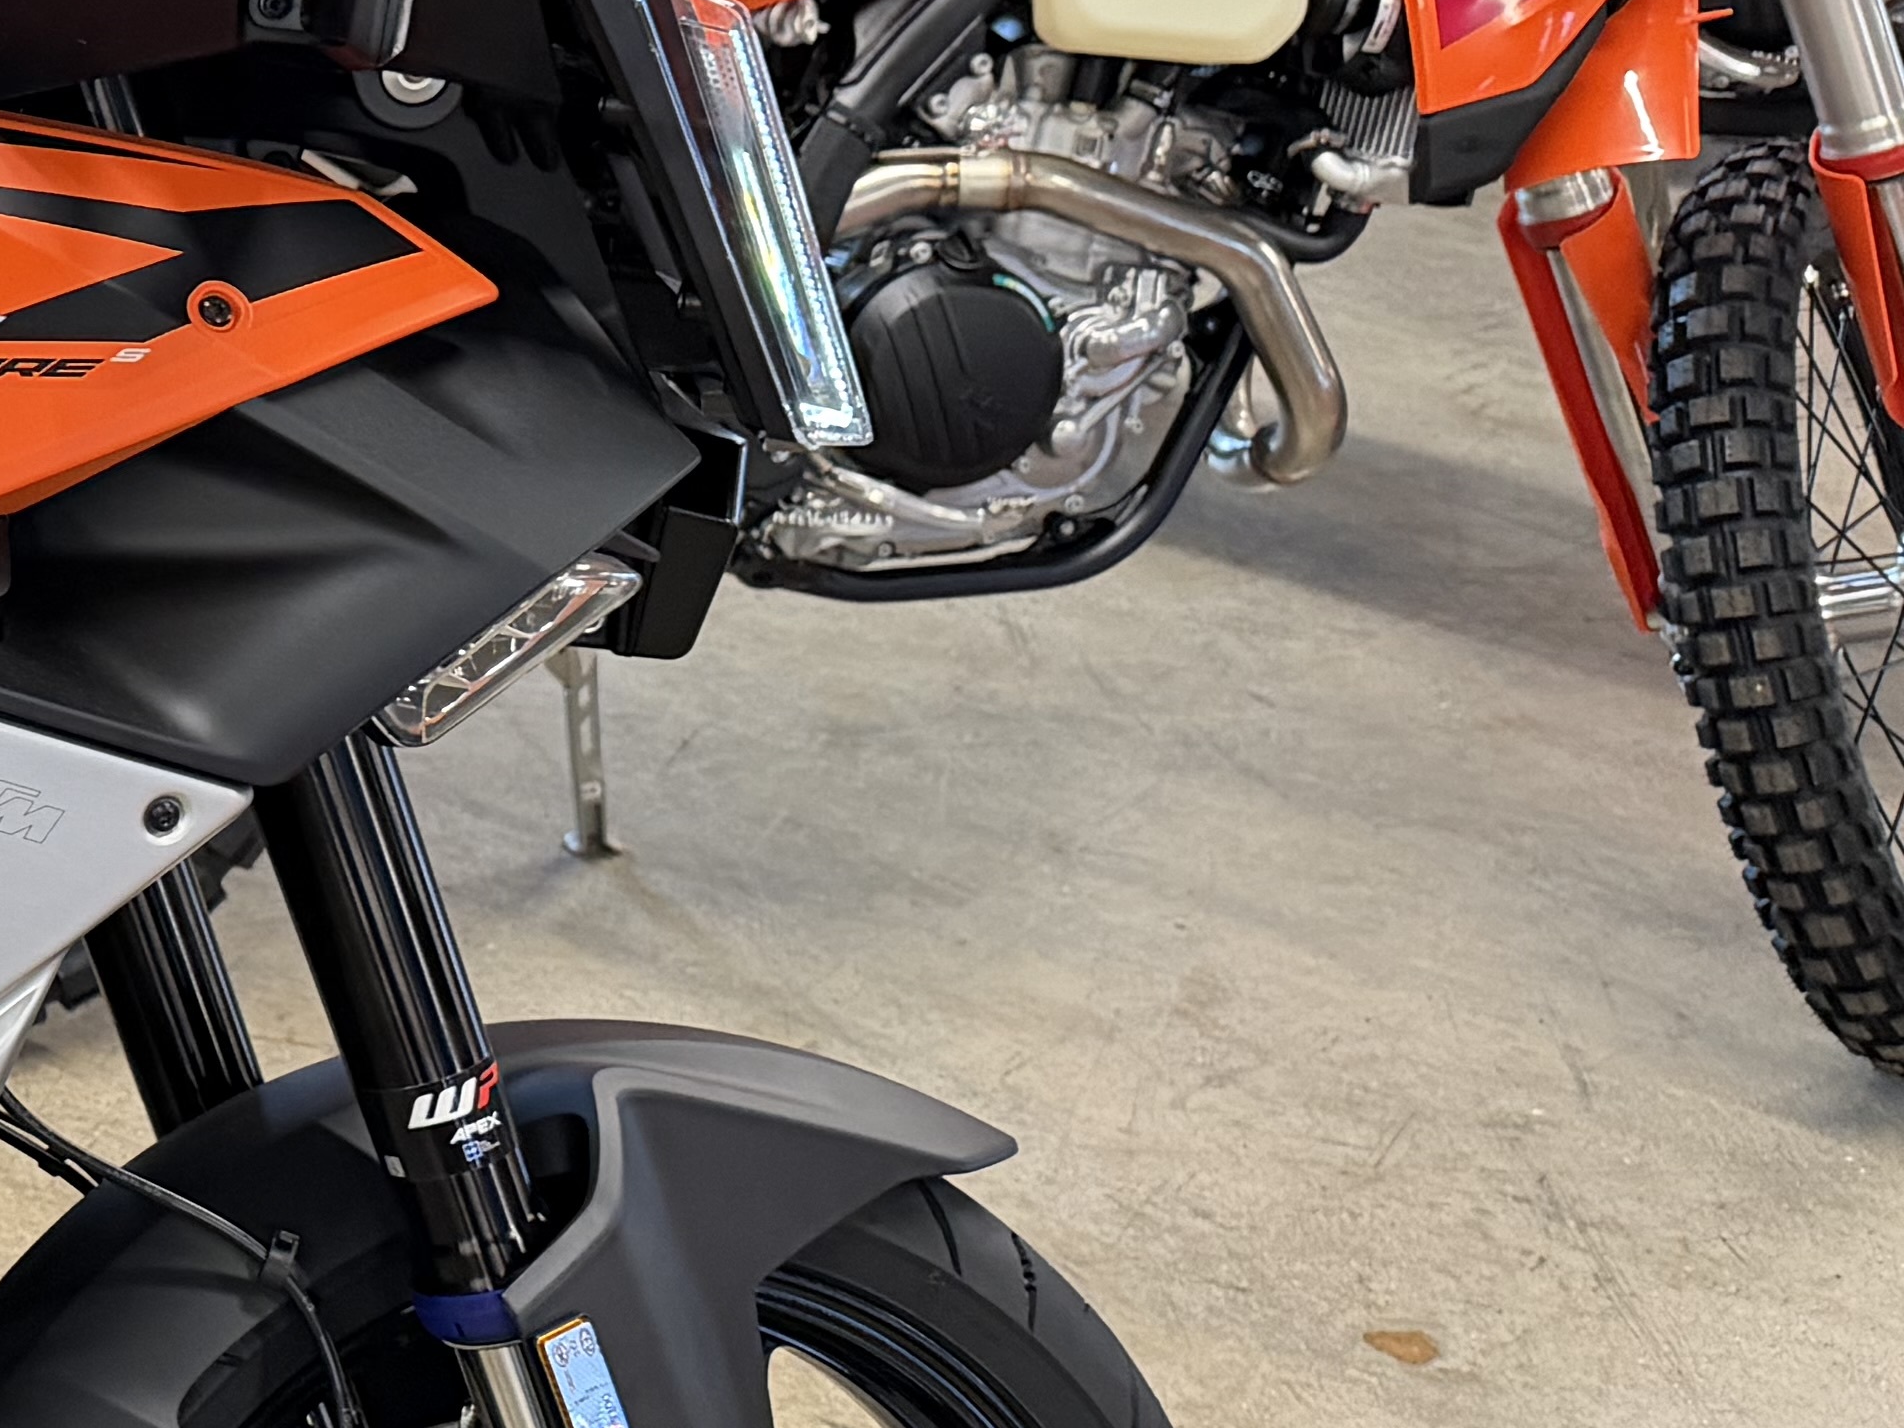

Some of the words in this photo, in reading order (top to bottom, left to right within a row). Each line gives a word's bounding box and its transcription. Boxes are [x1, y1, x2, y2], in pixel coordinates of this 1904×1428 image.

[109, 347, 152, 363] S
[407, 1060, 500, 1130] WP
[449, 1110, 502, 1145] APEX
